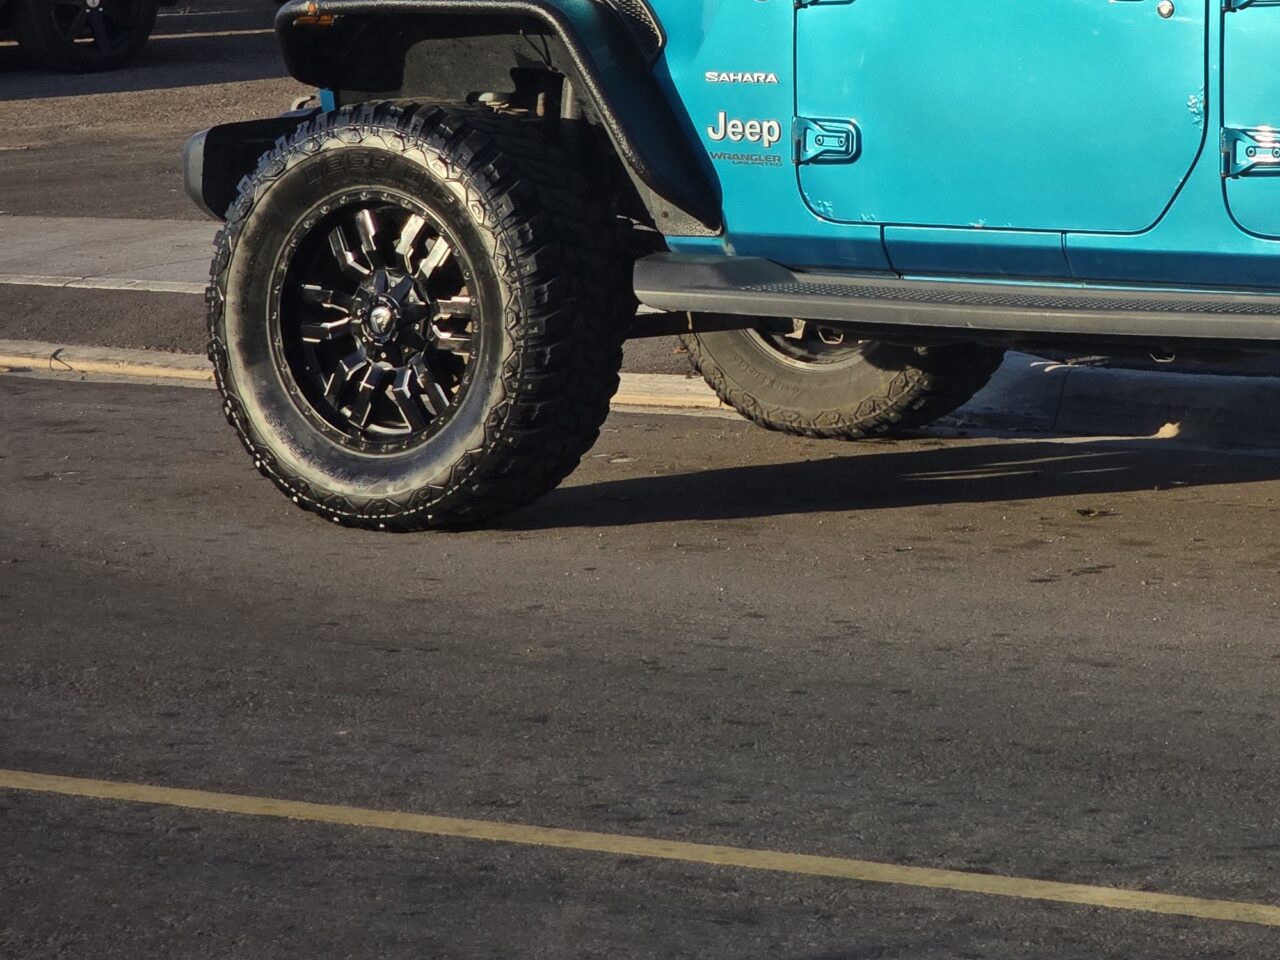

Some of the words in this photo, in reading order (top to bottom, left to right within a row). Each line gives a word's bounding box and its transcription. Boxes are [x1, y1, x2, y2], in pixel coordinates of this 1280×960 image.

[705, 71, 779, 84] SAHARA
[707, 111, 782, 148] Jeep
[709, 151, 783, 163] WRANGLER
